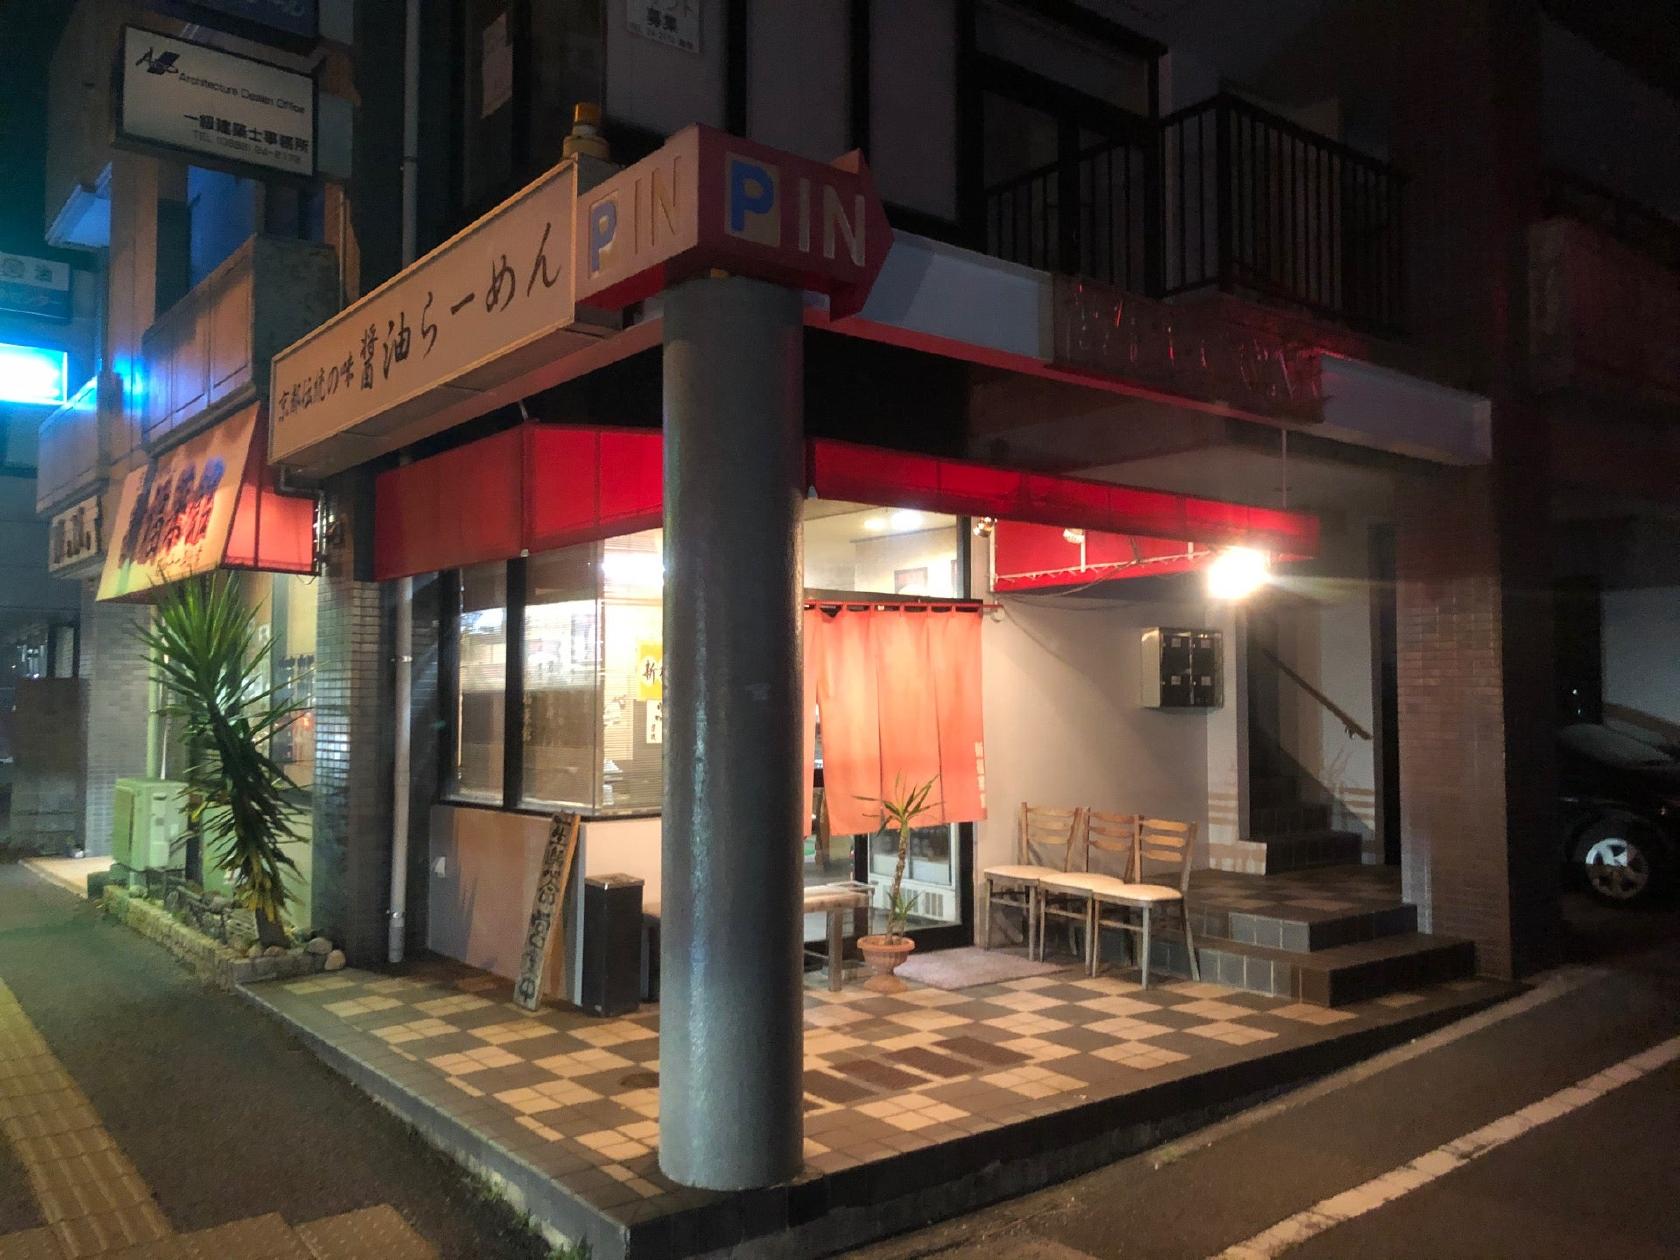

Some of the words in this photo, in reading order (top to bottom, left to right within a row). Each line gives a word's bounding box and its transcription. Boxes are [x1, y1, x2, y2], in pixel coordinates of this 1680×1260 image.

[184, 113, 309, 153] 一級建築士事務所
